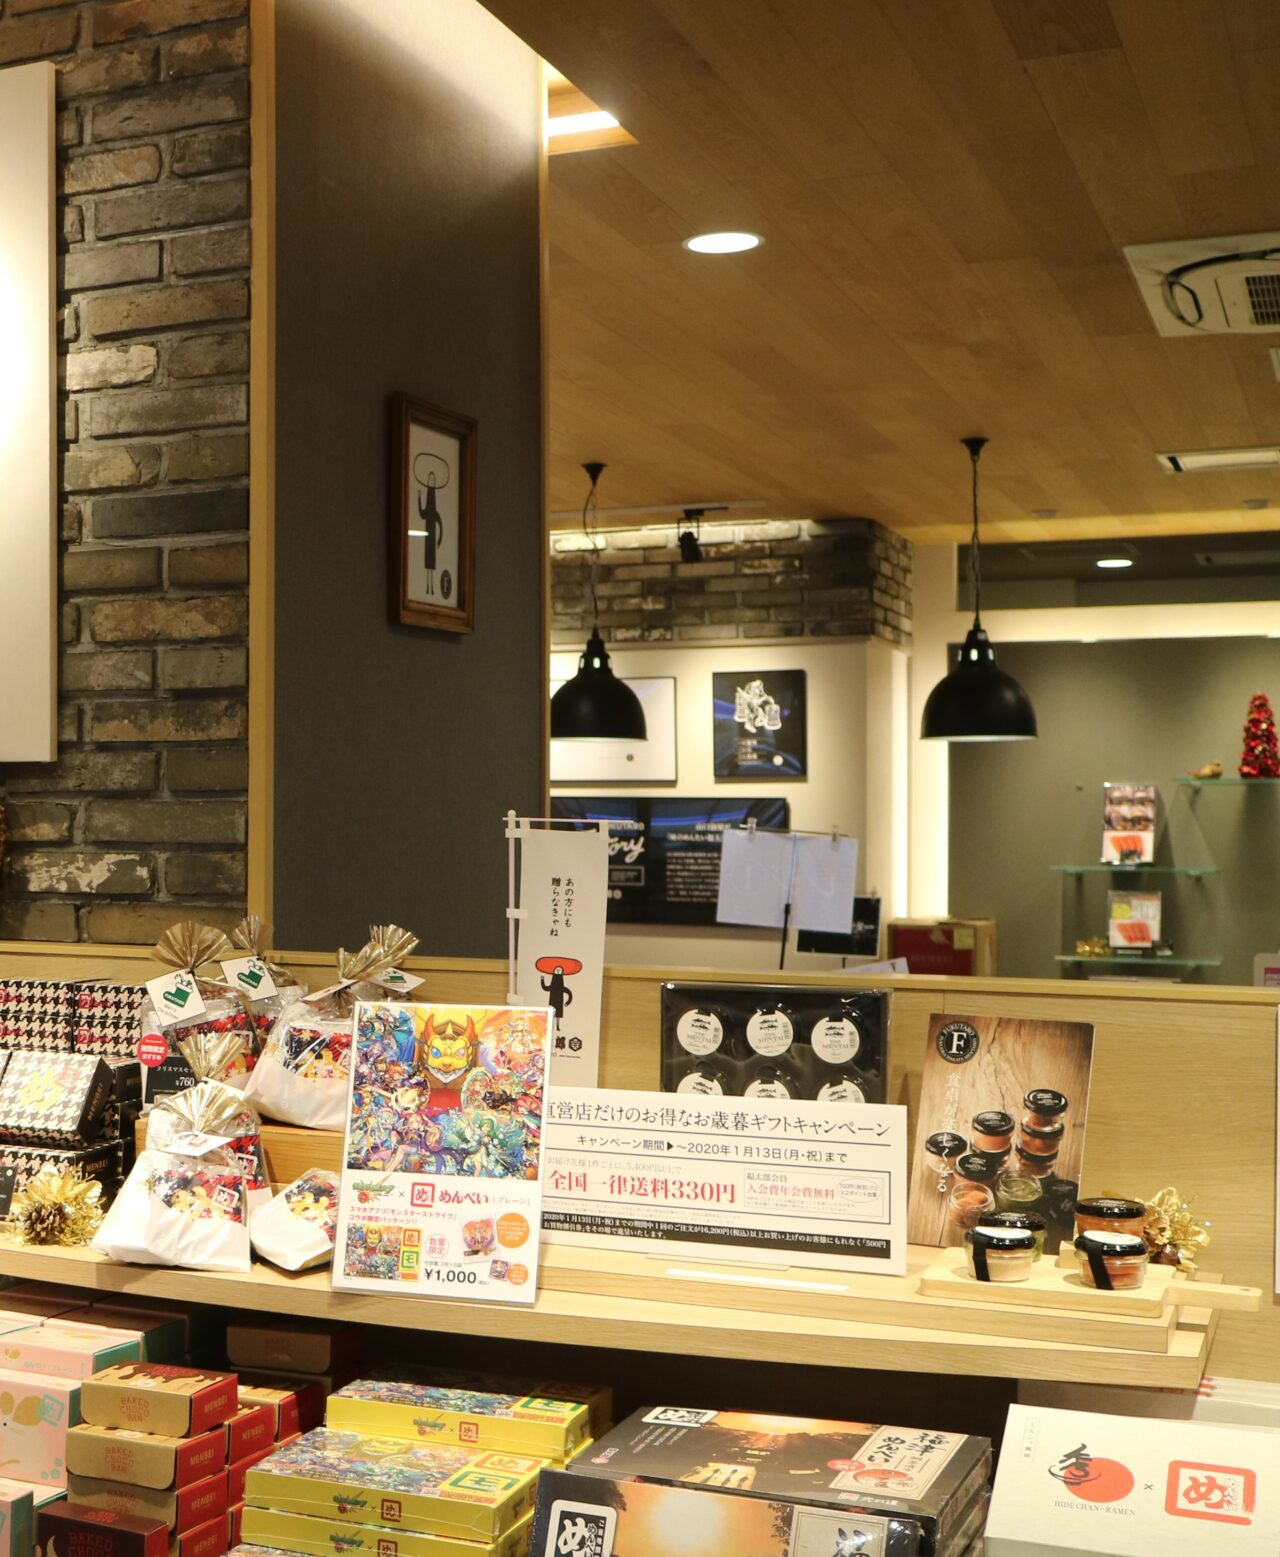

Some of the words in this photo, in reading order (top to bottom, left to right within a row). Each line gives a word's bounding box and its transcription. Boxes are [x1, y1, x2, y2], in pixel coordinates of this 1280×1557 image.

[608, 836, 645, 864] ory
[564, 877, 575, 928] あの方にも
[548, 1169, 736, 1204] 全国一律送料330円
[438, 1190, 488, 1205] めんべい
[424, 1268, 477, 1285] ¥1,000
[203, 1395, 229, 1413] MENBEI
[189, 1450, 215, 1467] MENBEI
[191, 1491, 217, 1510] MENBEI
[1054, 1499, 1075, 1510] HIDE
